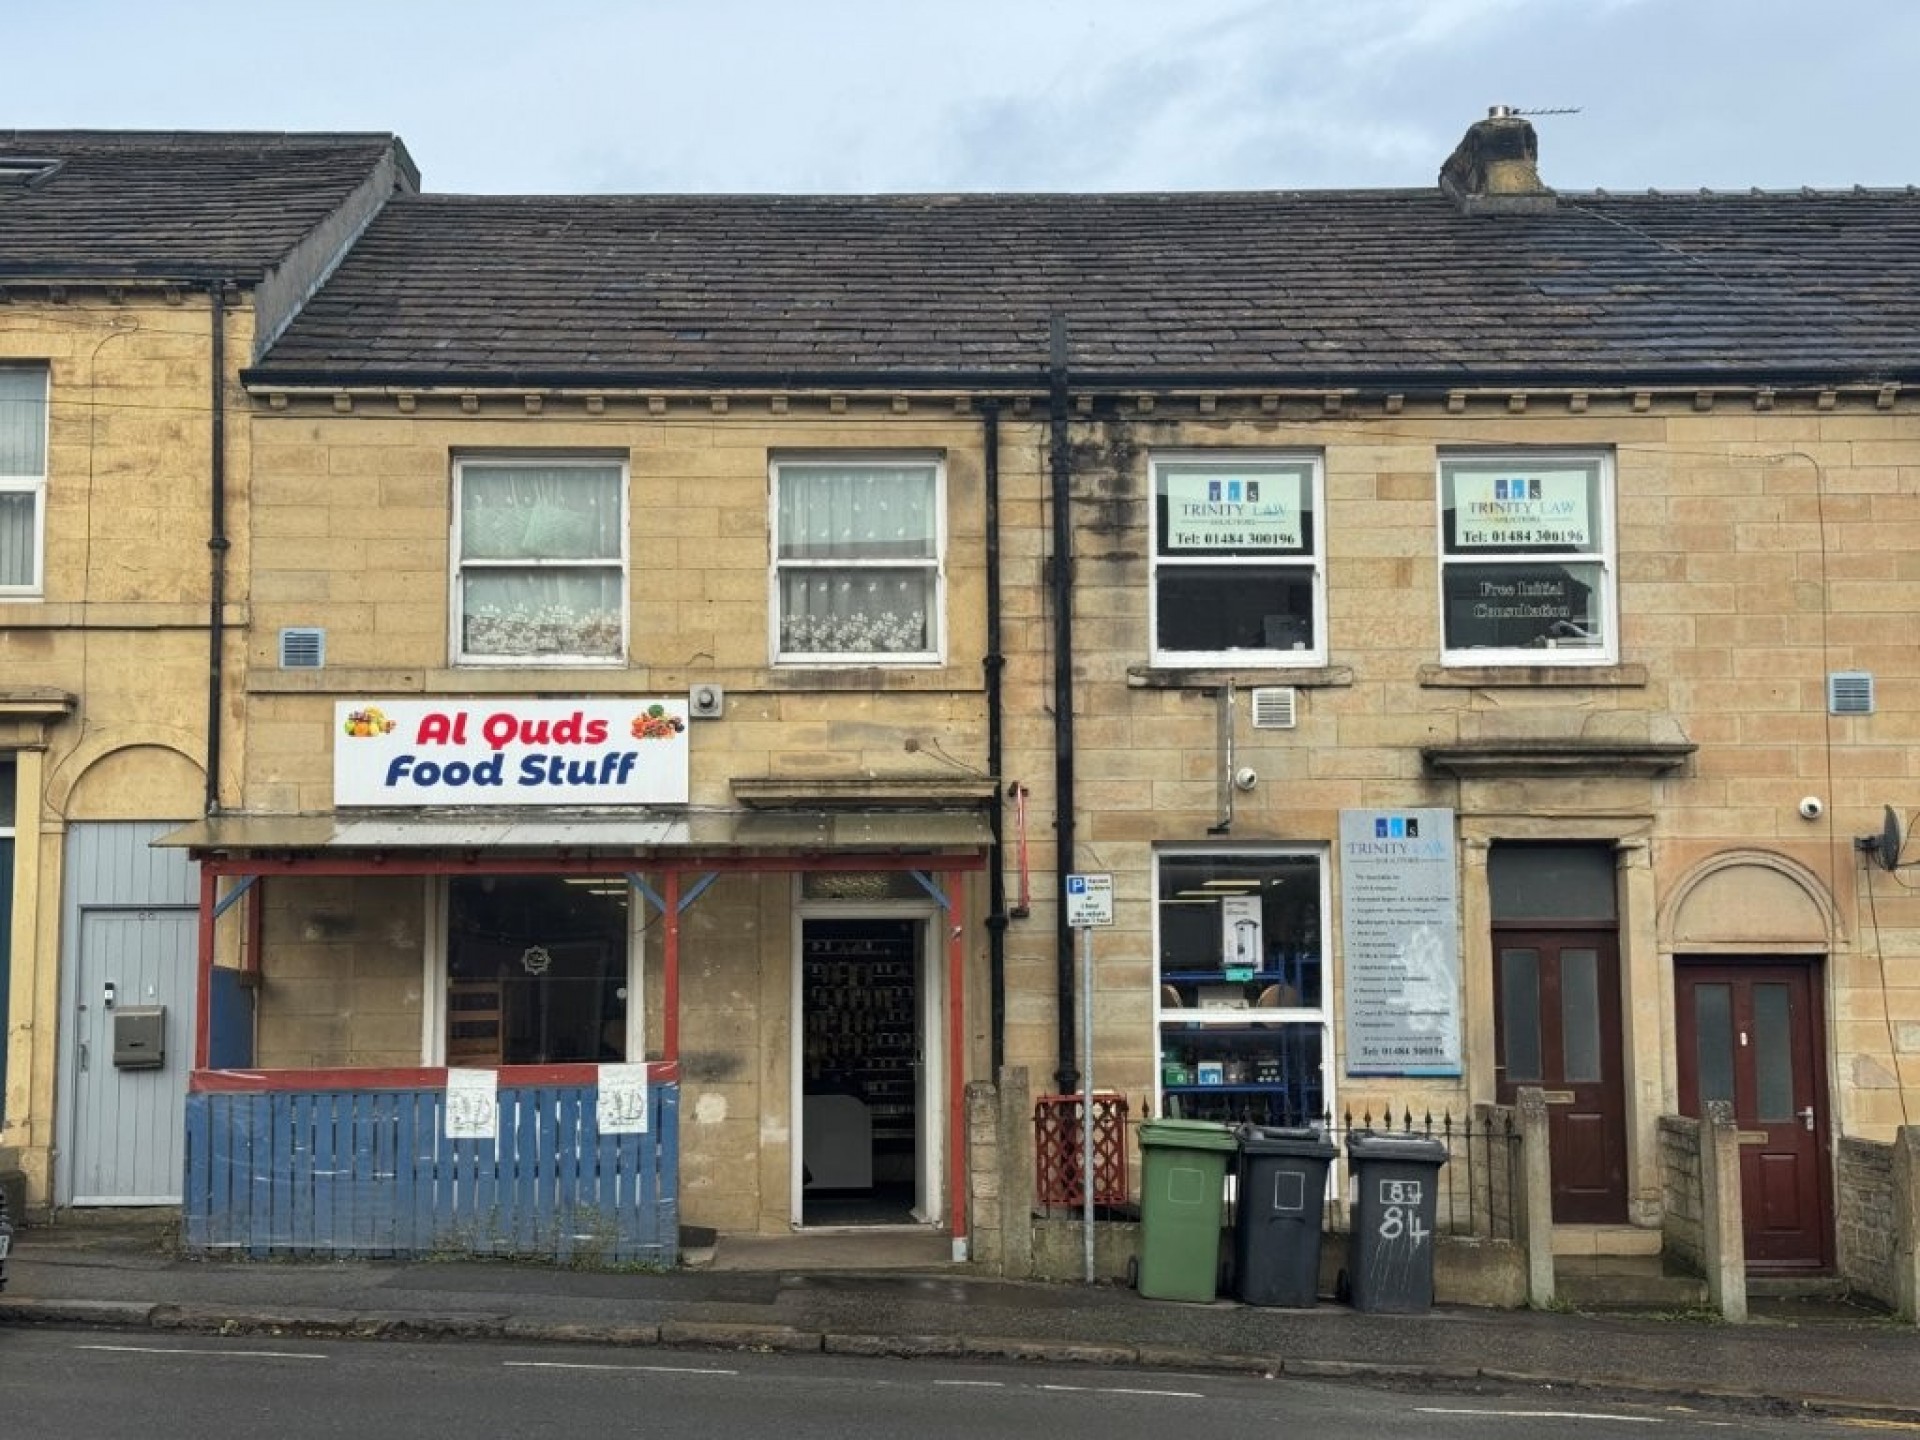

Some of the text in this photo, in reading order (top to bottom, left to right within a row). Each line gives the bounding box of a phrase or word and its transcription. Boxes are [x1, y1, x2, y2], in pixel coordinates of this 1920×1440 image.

[1181, 503, 1243, 516] TRINITY
[1468, 501, 1575, 514] TRINITY LAW
[1176, 531, 1296, 545] Tel: 01484 300196
[1463, 528, 1584, 543] Tel: 01484 300196
[416, 711, 609, 751] Al Quds
[385, 751, 639, 787] Food Stuff
[1349, 842, 1407, 854] TRINITY
[1379, 1206, 1430, 1245] 84
